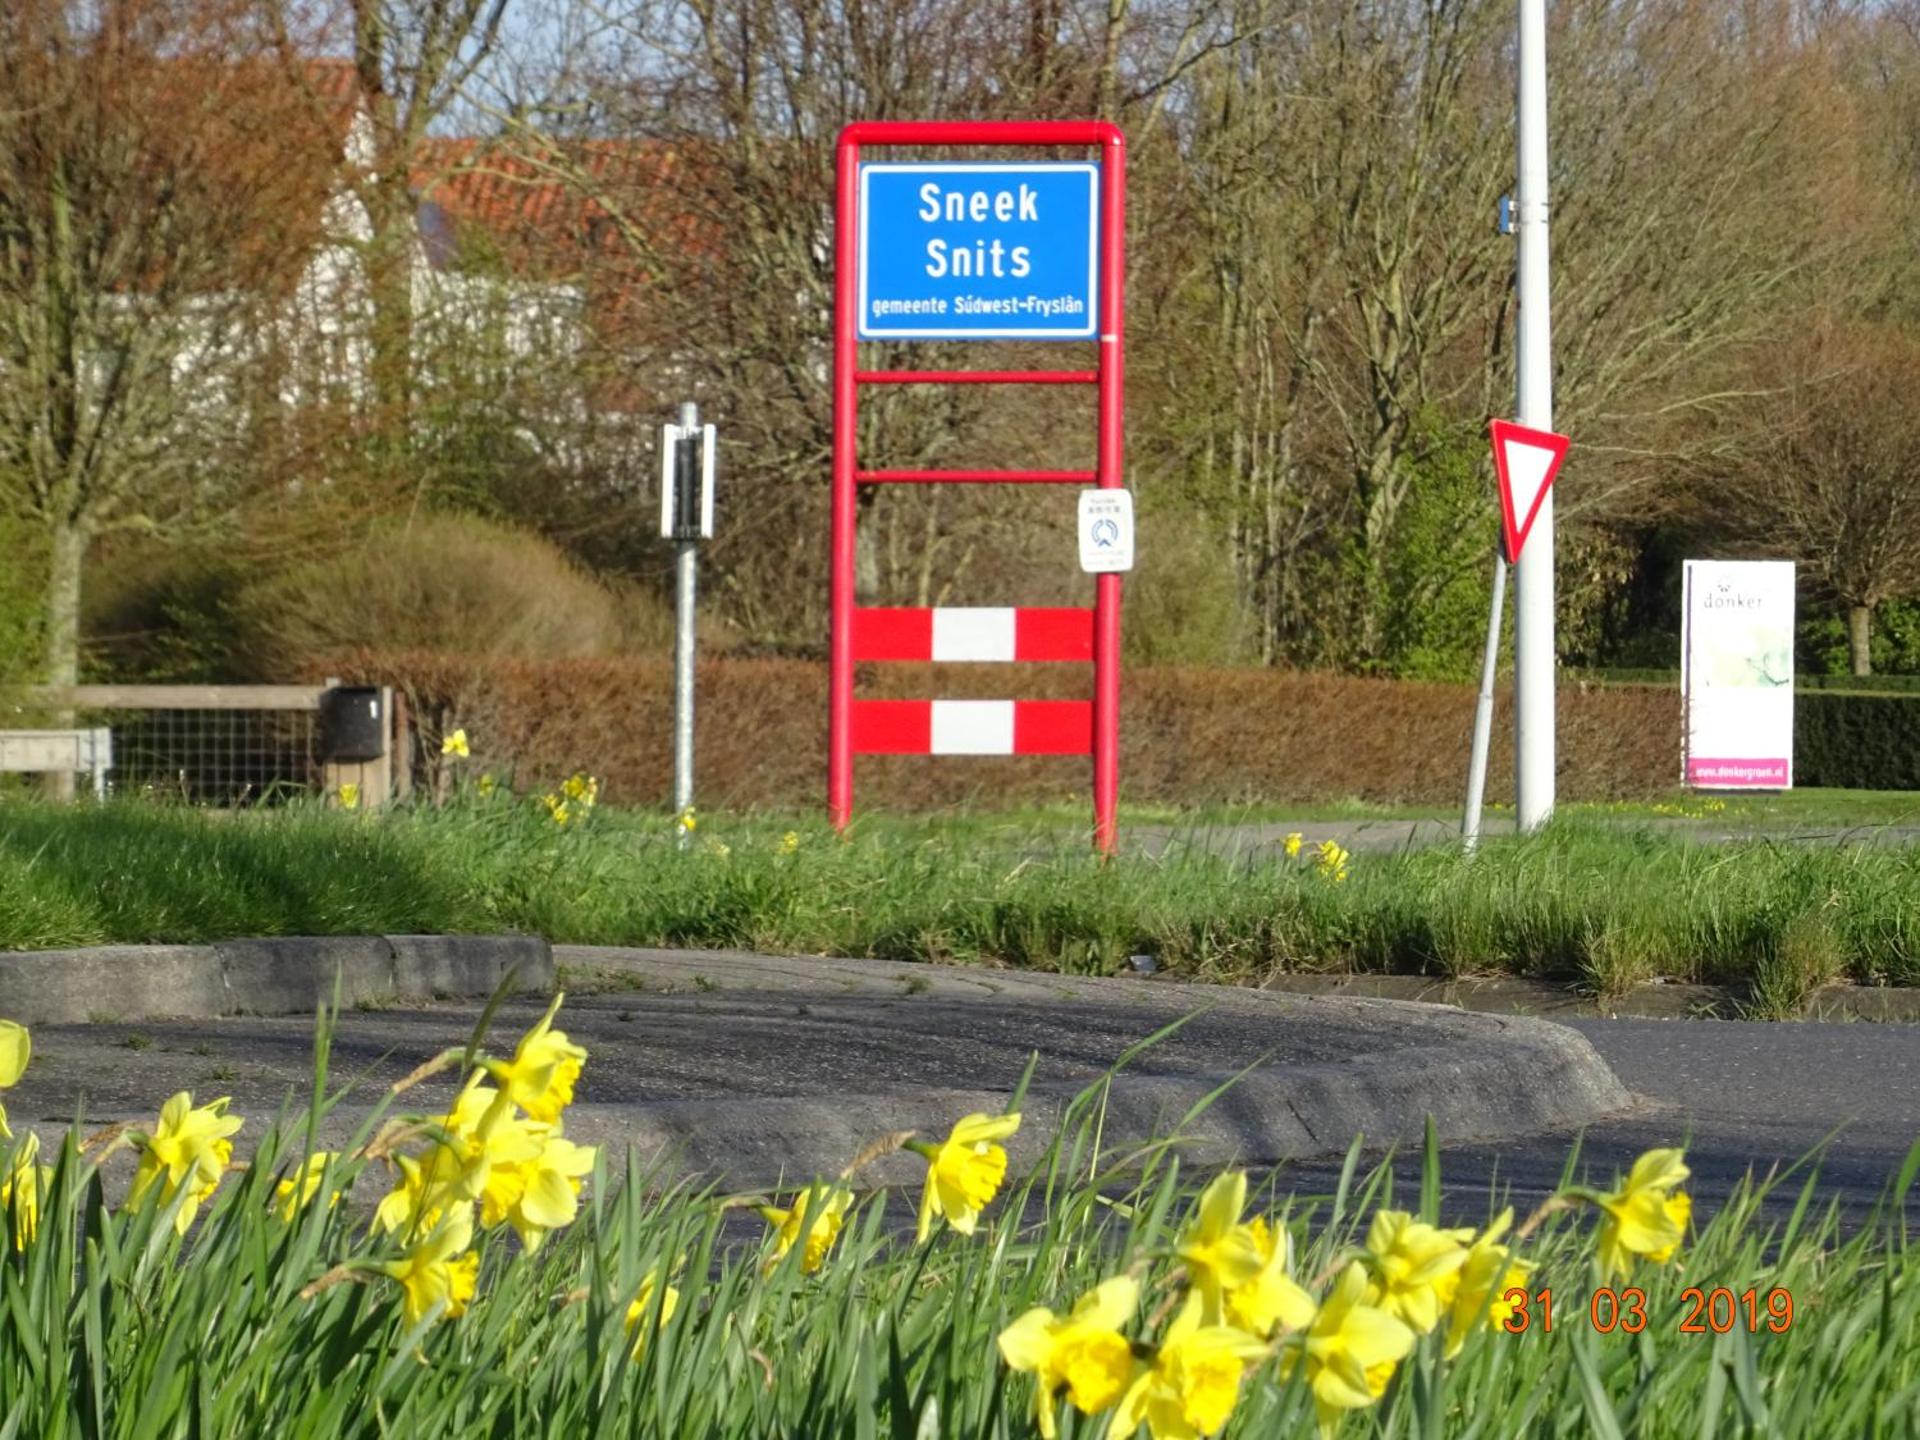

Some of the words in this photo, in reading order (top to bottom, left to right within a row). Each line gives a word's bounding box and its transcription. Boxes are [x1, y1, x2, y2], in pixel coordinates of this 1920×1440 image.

[919, 182, 1039, 222] Sneek
[925, 238, 1031, 278] Snits
[872, 297, 947, 317] gemeente
[954, 294, 1083, 317] Súdwest-Fryslân
[1703, 592, 1762, 609] donker
